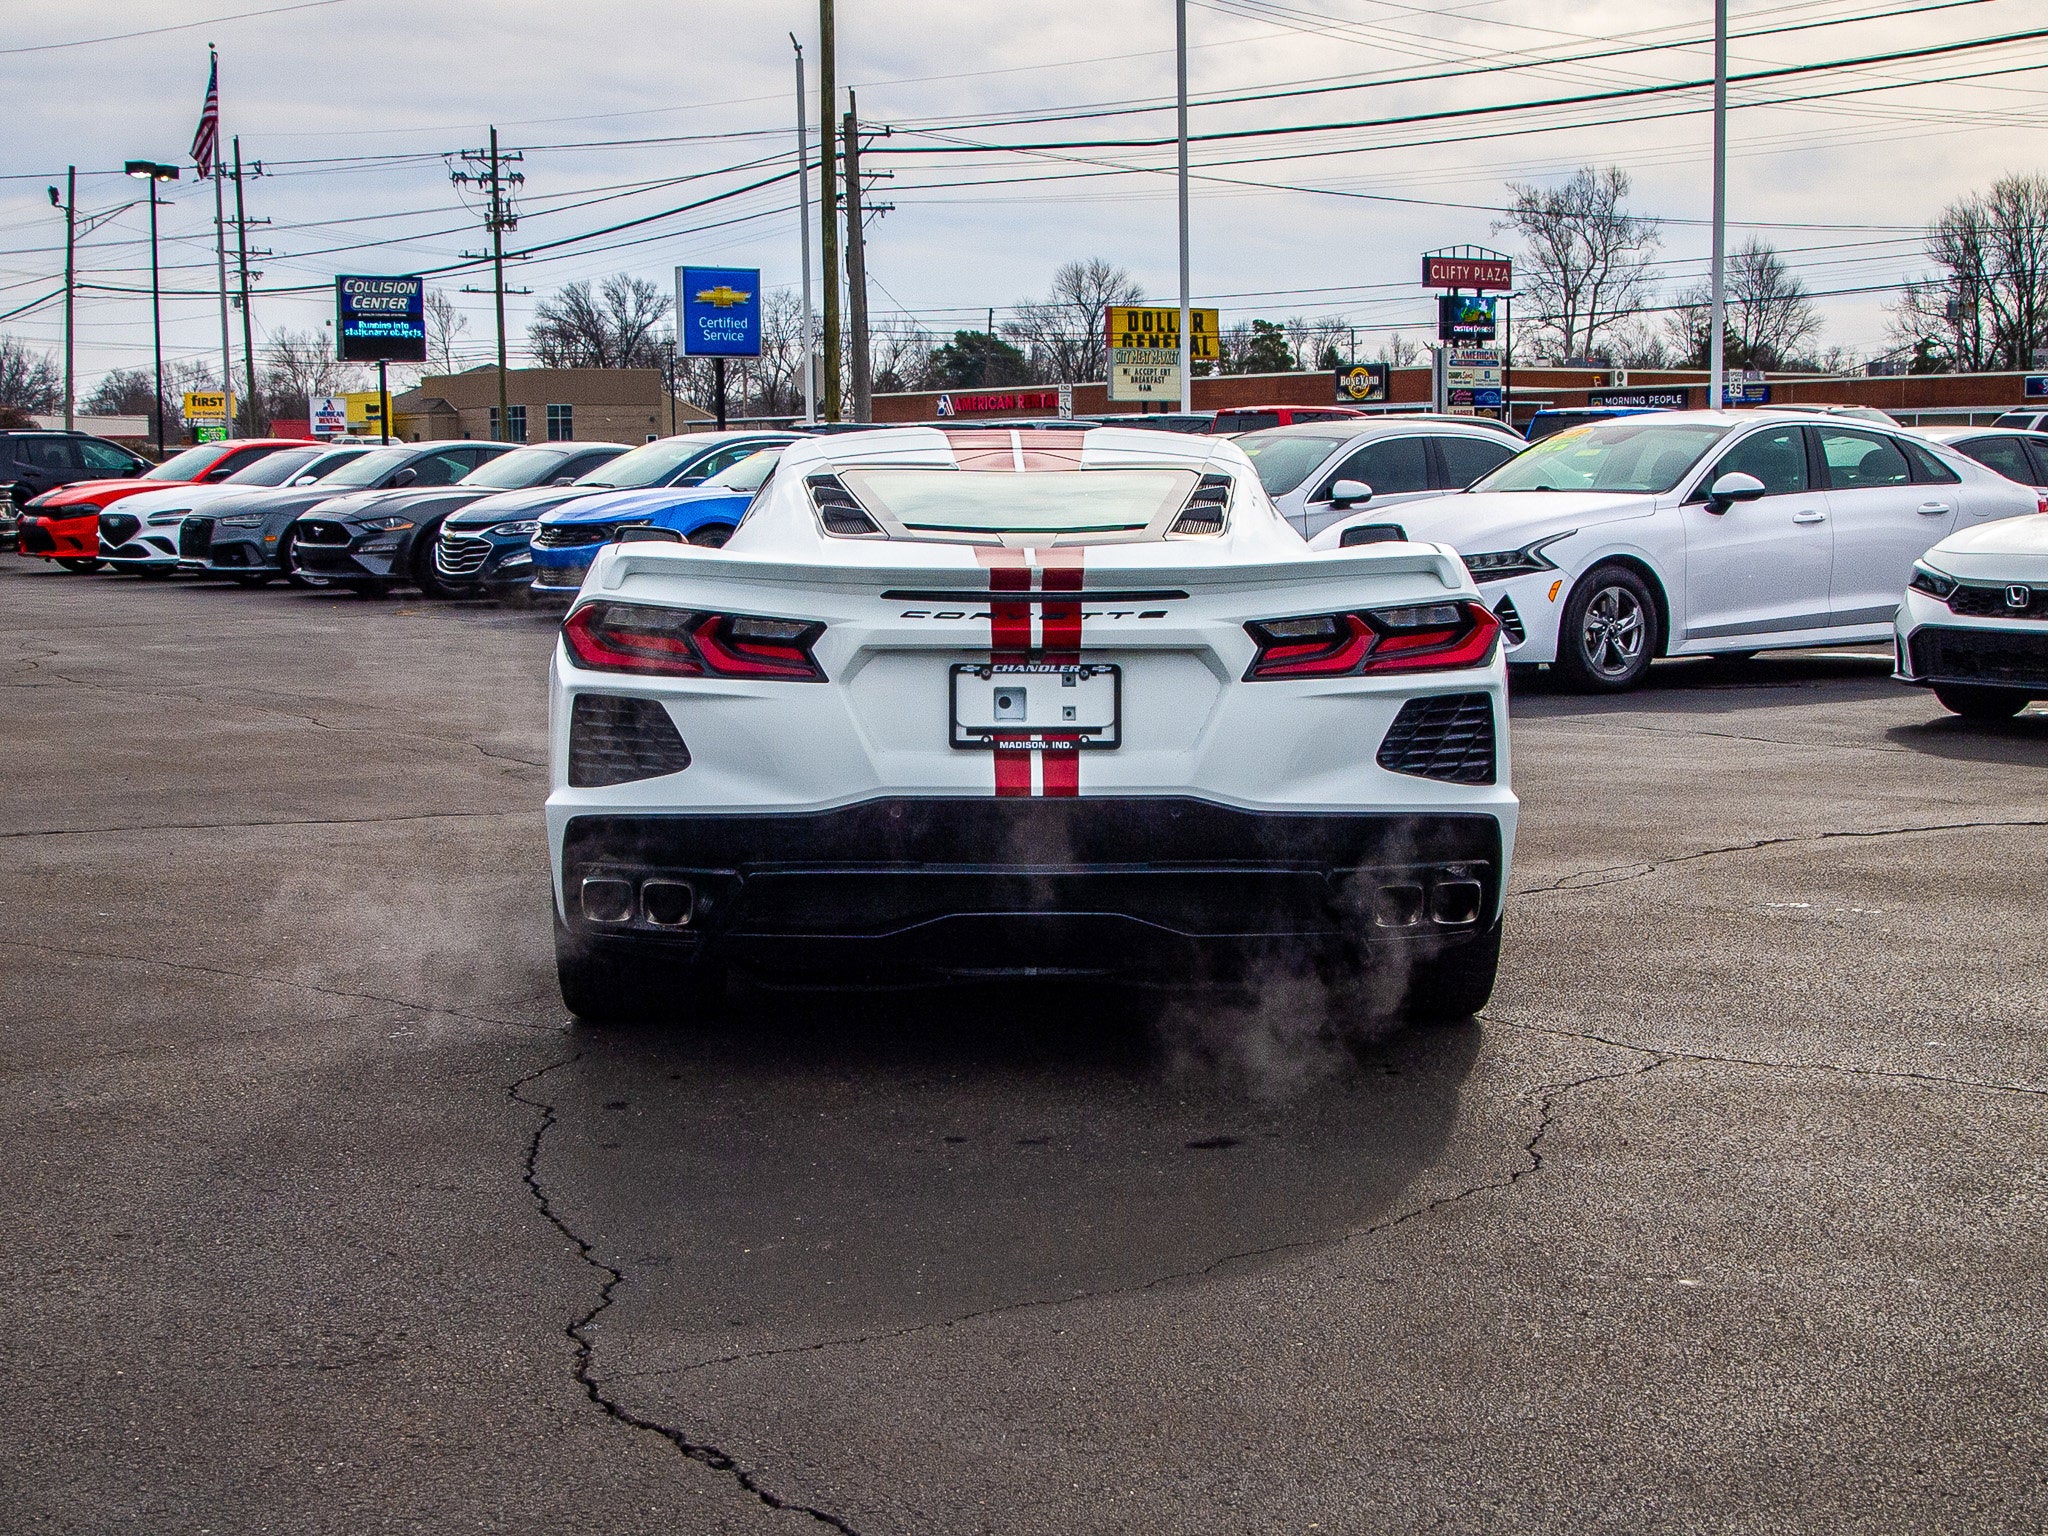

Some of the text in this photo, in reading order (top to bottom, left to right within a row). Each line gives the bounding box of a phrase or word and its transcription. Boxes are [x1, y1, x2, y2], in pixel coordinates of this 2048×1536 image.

[1431, 264, 1509, 282] CLIFTY PLAZA
[344, 279, 418, 294] COLLISION
[352, 295, 408, 309] CENTER
[699, 316, 748, 329] Certified
[1127, 310, 1205, 333] DOLLR
[703, 329, 745, 342] Service
[1116, 350, 1180, 365] CITY MEAT MARKET
[1460, 350, 1499, 360] AMERICAN
[1134, 368, 1158, 376] ACCEPT
[1160, 368, 1171, 376] EBT
[1130, 376, 1165, 384] BREAKFAST
[1729, 383, 1742, 395] 35
[954, 394, 1015, 412] AMERICAN
[1605, 394, 1682, 406] MORNING PEOPLE
[318, 417, 340, 425] RENTAL
[900, 610, 1169, 620] CORVETTE
[992, 664, 1081, 673] CHANDLER
[1052, 741, 1073, 749] IND.
